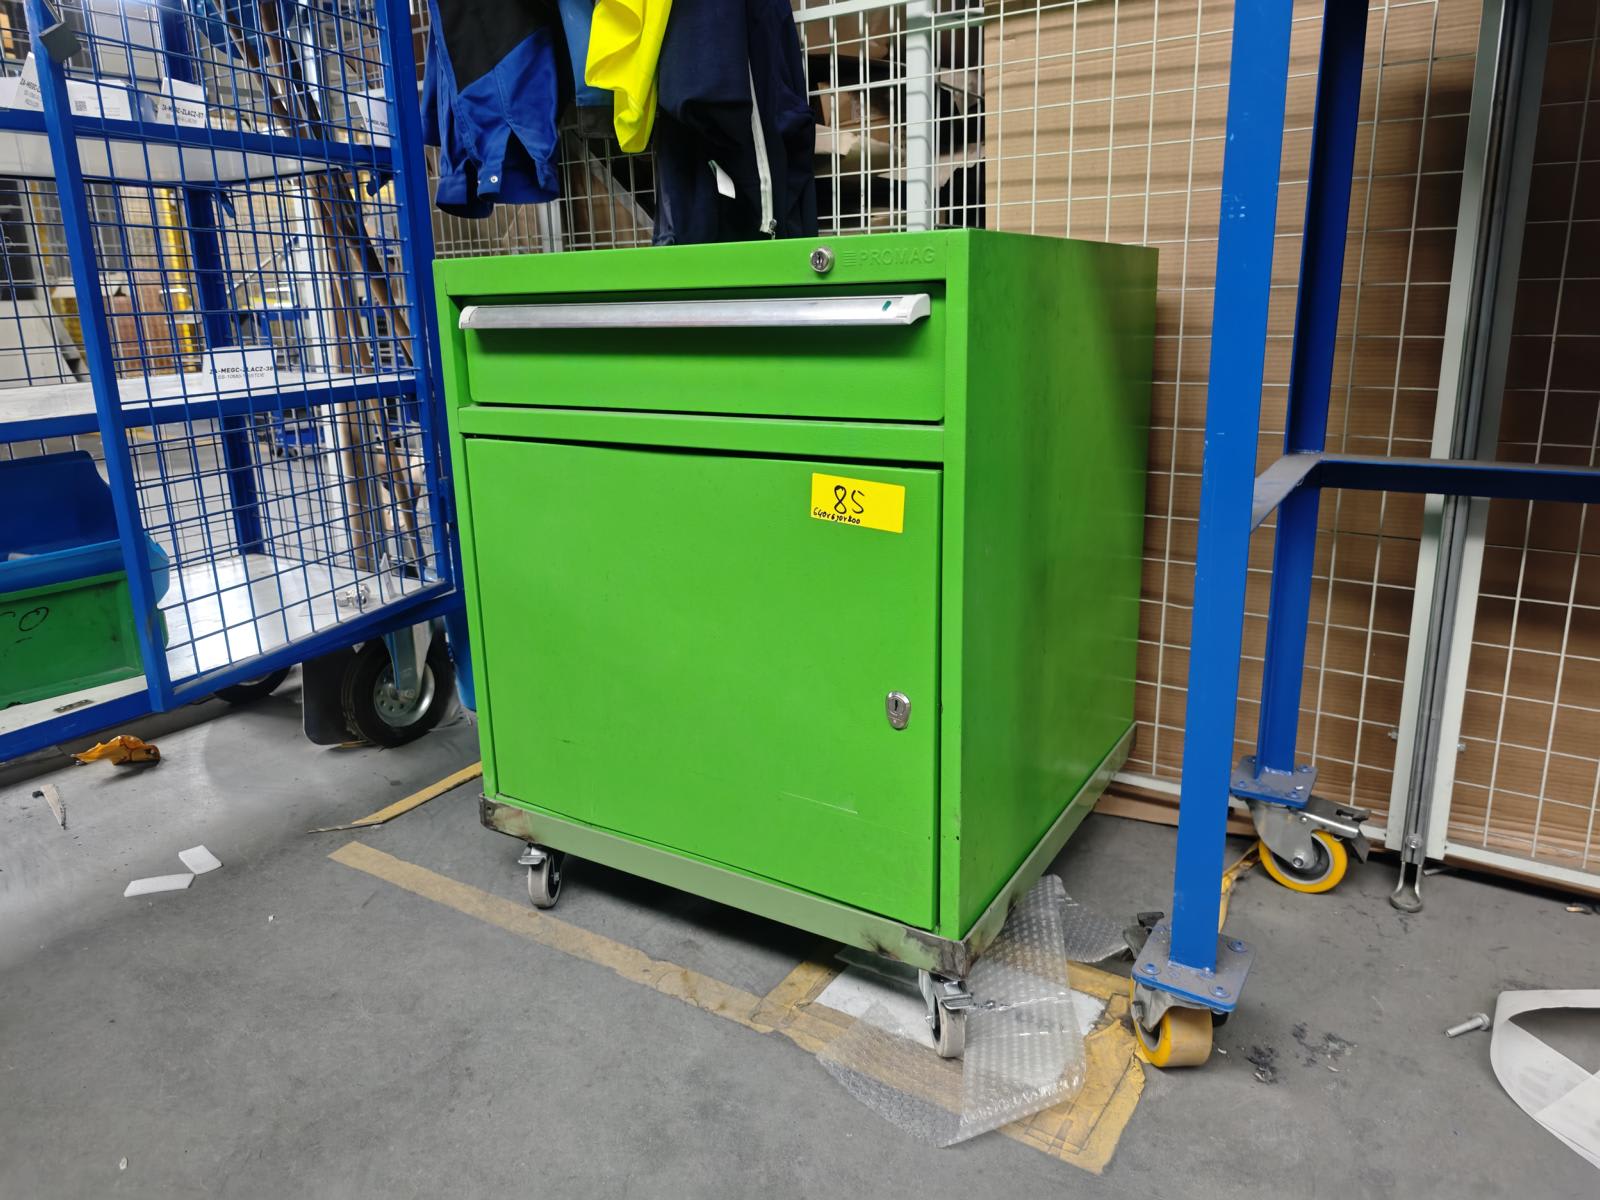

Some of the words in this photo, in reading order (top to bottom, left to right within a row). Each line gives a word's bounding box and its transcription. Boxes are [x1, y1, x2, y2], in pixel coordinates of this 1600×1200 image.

[859, 246, 936, 266] PROMAG
[209, 365, 274, 375] Z-MEGC-LACZ-38
[834, 485, 865, 514] 85
